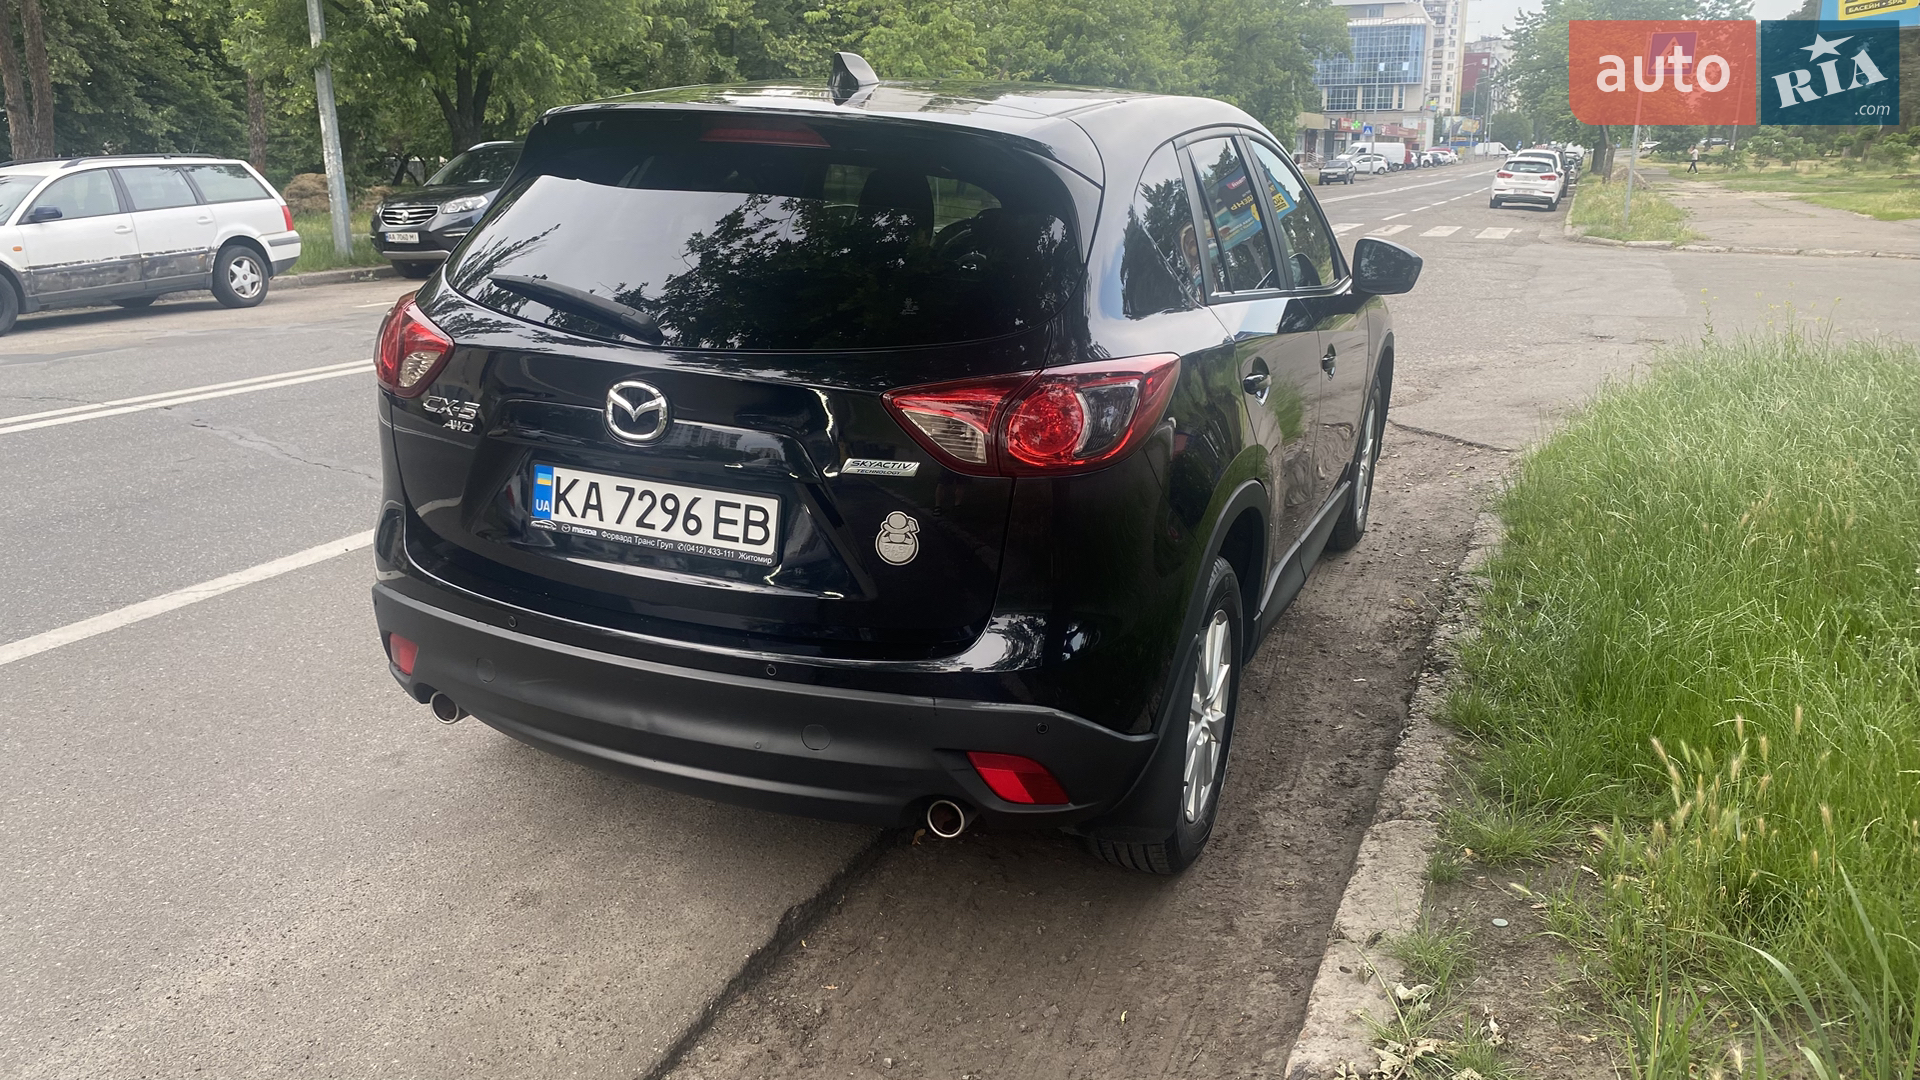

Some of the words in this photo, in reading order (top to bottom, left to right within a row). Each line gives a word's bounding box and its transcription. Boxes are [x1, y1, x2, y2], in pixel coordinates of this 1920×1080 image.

[1848, 3, 1880, 13] БАСЕЙН
[423, 395, 481, 420] CX-5
[442, 419, 474, 433] AWD
[850, 460, 912, 470] SKYACTIV
[535, 498, 551, 513] UA
[554, 475, 604, 522] KA
[615, 485, 703, 536] 7296
[713, 499, 770, 546] EB
[572, 526, 598, 537] mazda
[601, 530, 633, 544] Форвард
[634, 535, 656, 547] Транс
[656, 540, 674, 550] Груп
[683, 543, 706, 555] (0412)
[707, 548, 735, 559] 433-111
[738, 551, 773, 565] Житомир
